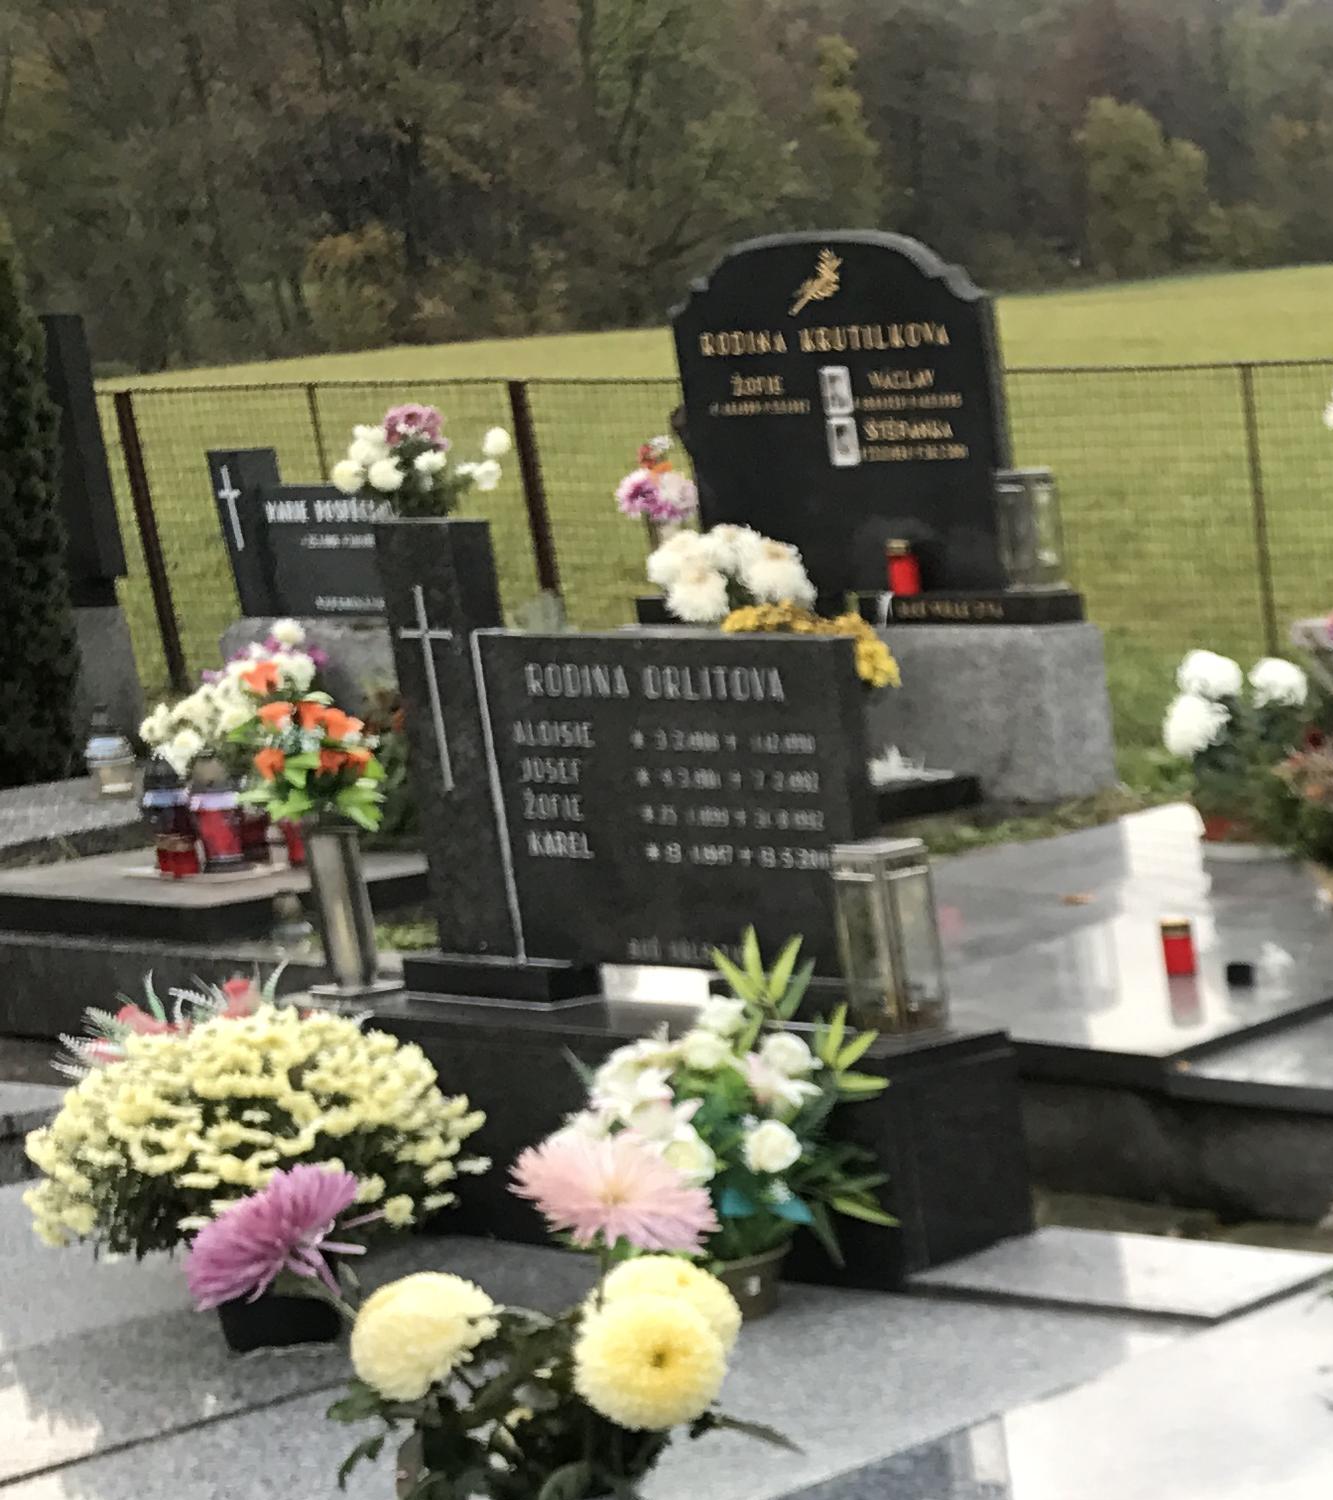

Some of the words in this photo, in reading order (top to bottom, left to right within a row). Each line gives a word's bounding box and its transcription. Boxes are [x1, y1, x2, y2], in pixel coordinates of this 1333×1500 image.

[700, 330, 788, 357] RODINA
[524, 663, 630, 699] RODINA
[527, 831, 595, 859] KAREL
